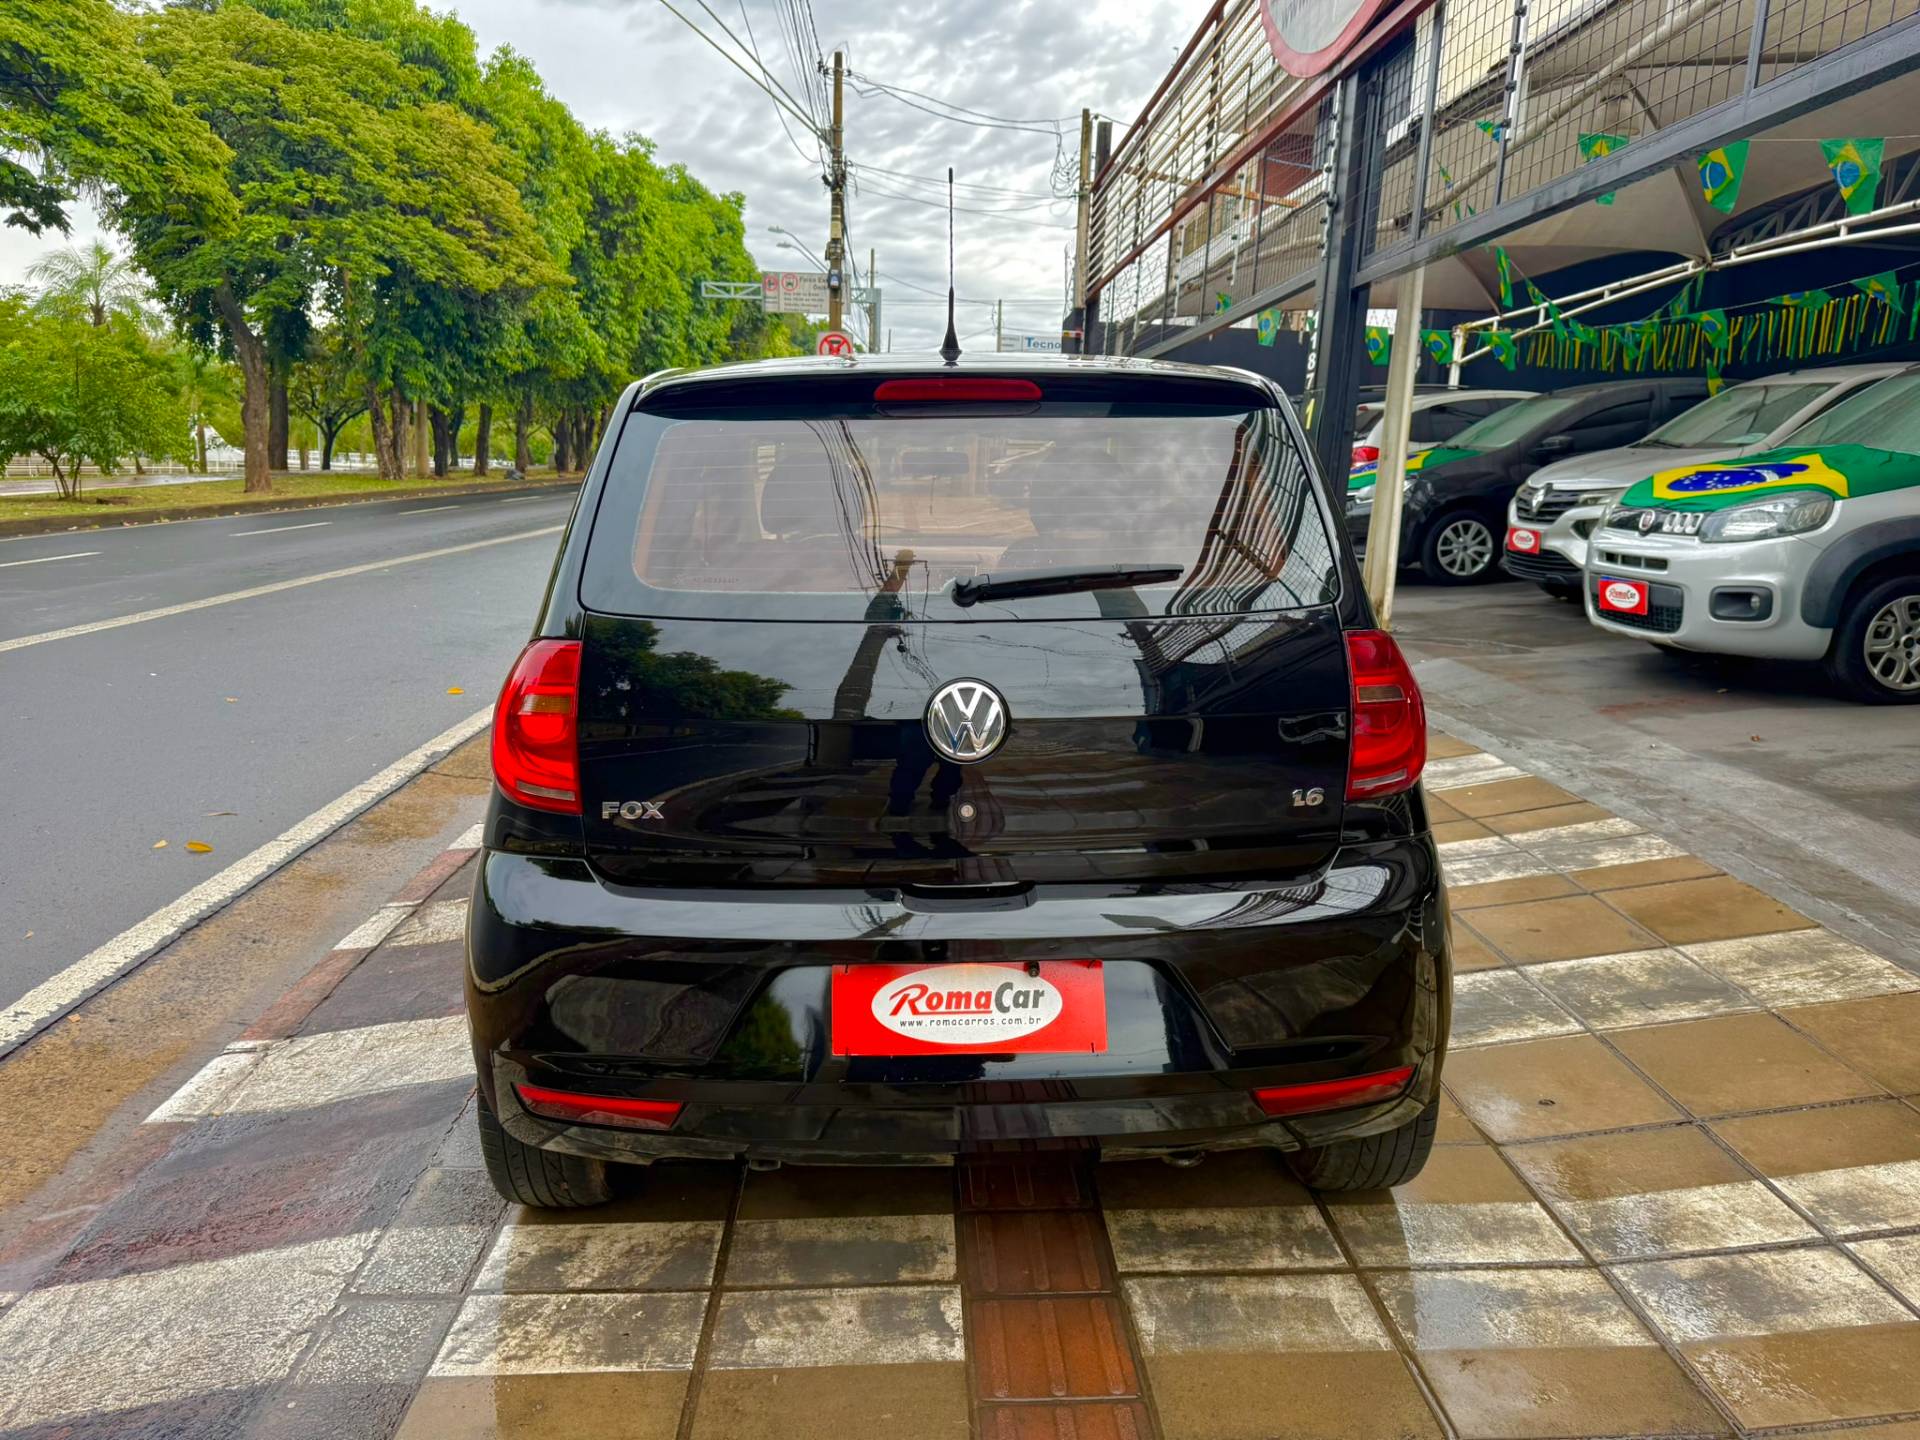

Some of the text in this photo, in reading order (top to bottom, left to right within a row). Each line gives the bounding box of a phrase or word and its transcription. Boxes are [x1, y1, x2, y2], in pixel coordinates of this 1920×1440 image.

[601, 801, 666, 820] FOX
[889, 982, 1045, 1016] RomaCar
[899, 1015, 1042, 1028] www.romacarros.com.br
